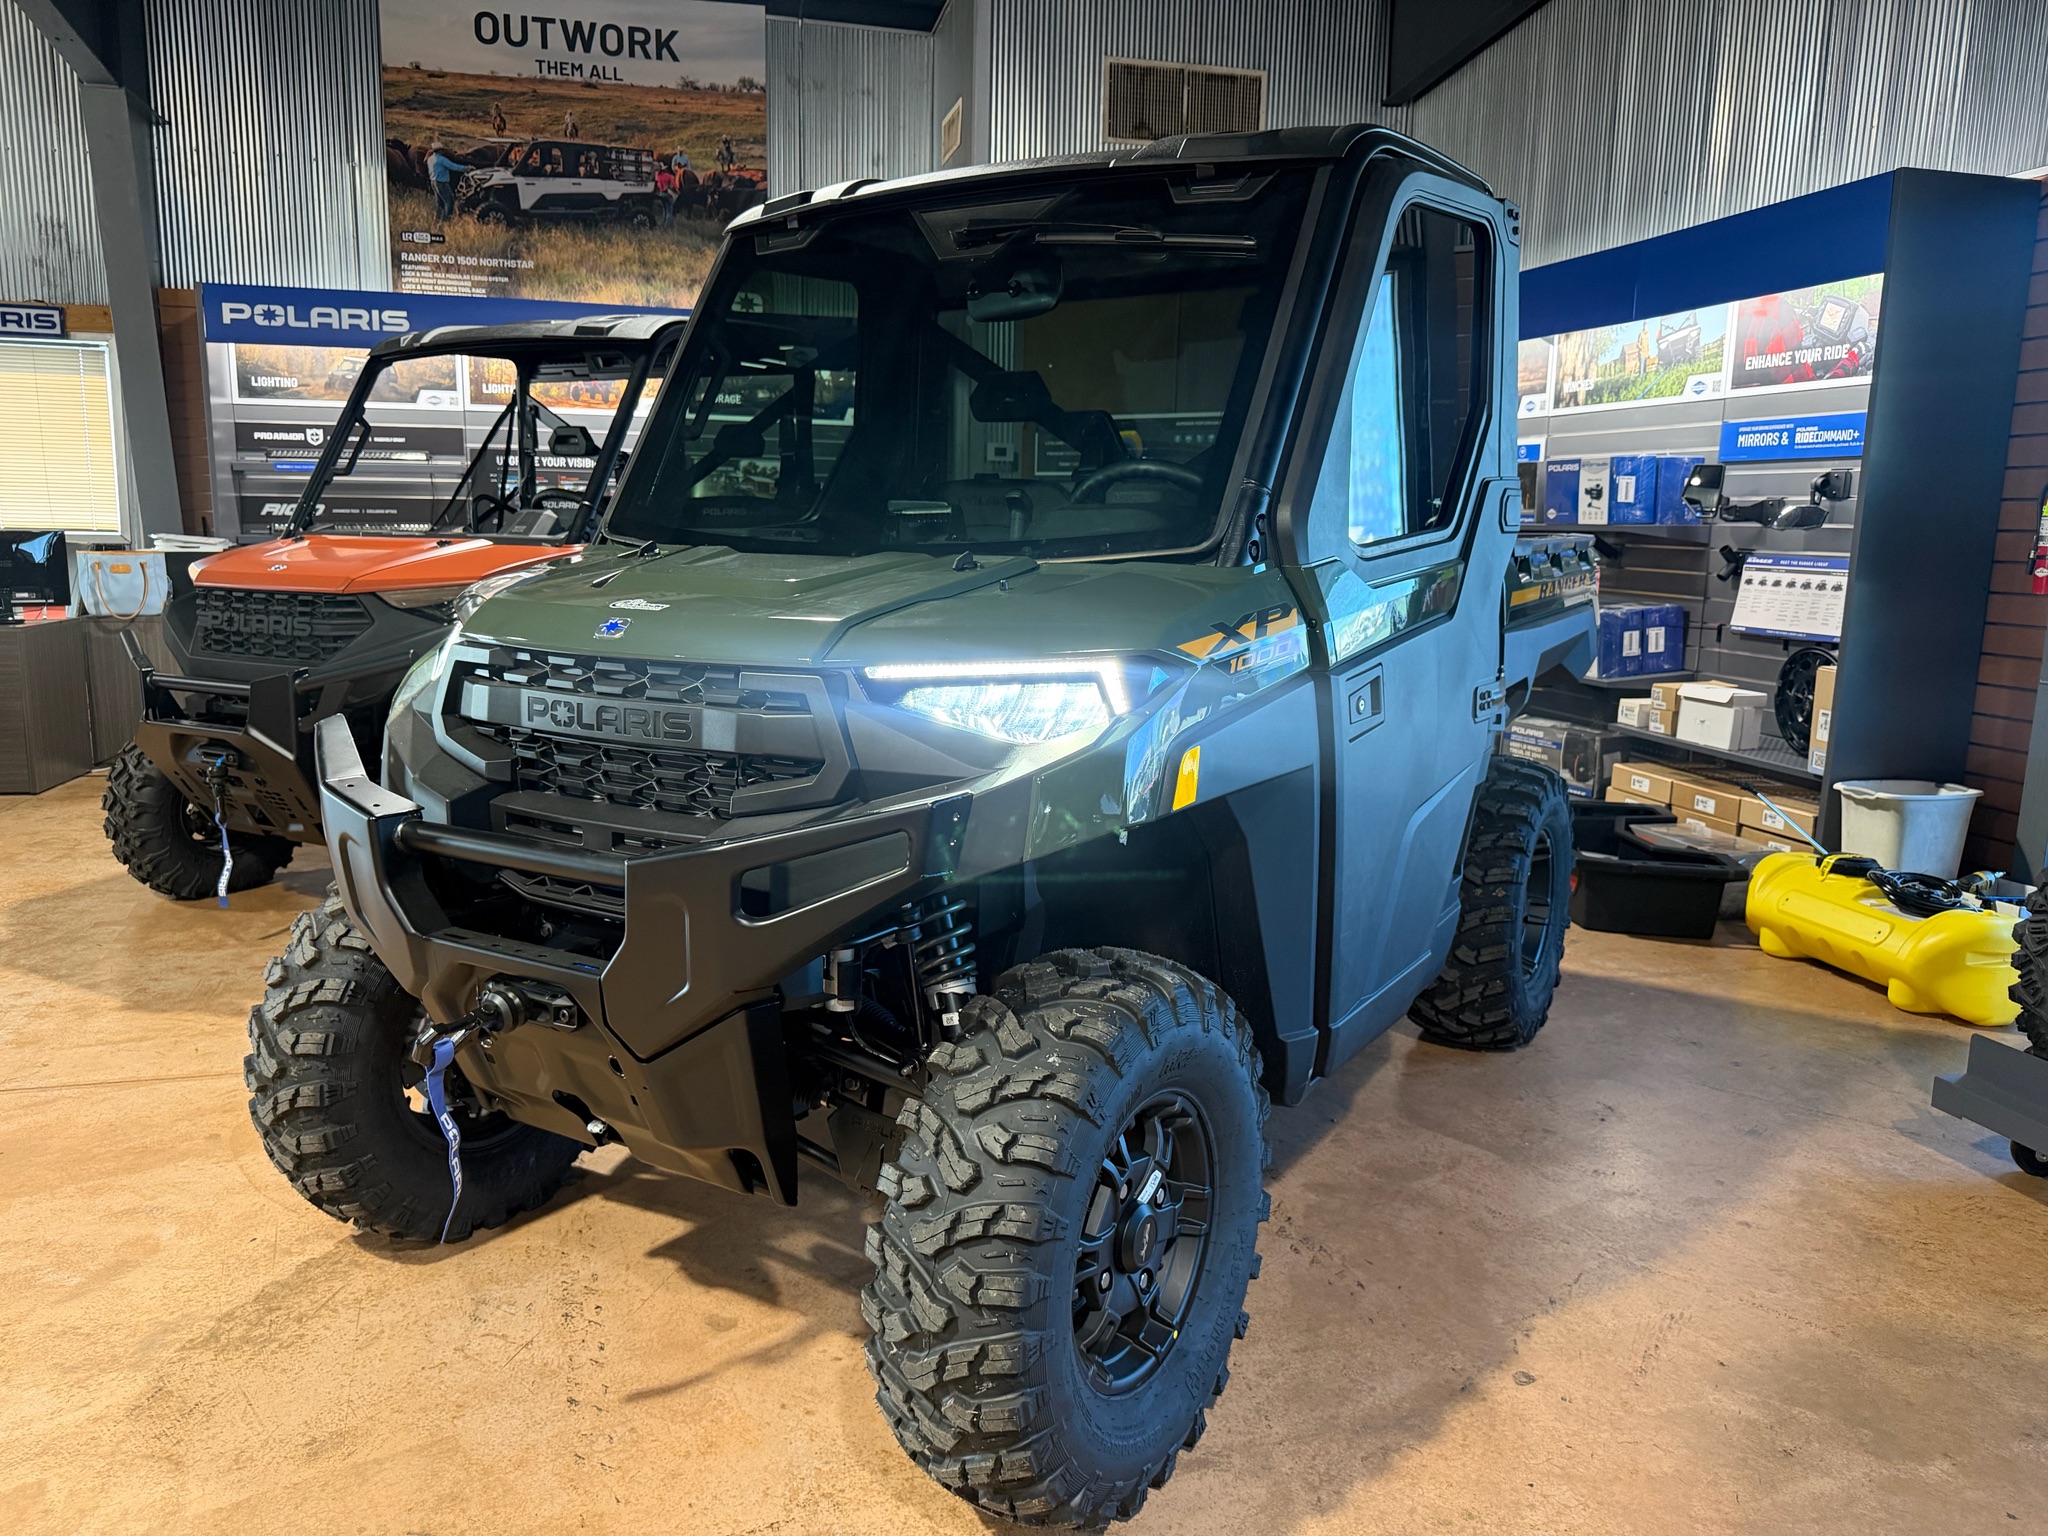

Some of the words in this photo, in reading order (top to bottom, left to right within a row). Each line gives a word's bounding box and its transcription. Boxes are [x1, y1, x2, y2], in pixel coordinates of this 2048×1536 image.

[474, 11, 680, 62] OUTWORK
[535, 59, 583, 77] THEM
[590, 64, 624, 81] ALL
[401, 252, 440, 263] RANGER
[442, 254, 455, 264] XD
[456, 256, 478, 266] 1500
[480, 257, 534, 269] NORTHSTAR
[221, 302, 411, 333] POLARIS
[1745, 351, 1792, 371] ENHANCE
[1794, 349, 1822, 365] YOUR
[1824, 343, 1850, 360] RIDE
[251, 376, 298, 388] LIGHTING
[1563, 379, 1595, 393] WINCHES
[1737, 432, 1779, 448] MIRRORS
[1780, 431, 1790, 445] &
[541, 457, 567, 468] YOUR
[1547, 463, 1579, 473] POLARIS
[208, 610, 312, 637] POLARIS
[1204, 602, 1294, 657] XP
[1229, 638, 1292, 674] 1000
[527, 695, 694, 743] POLARIS
[1511, 726, 1544, 738] POLARIS
[217, 849, 234, 897] POLARIS
